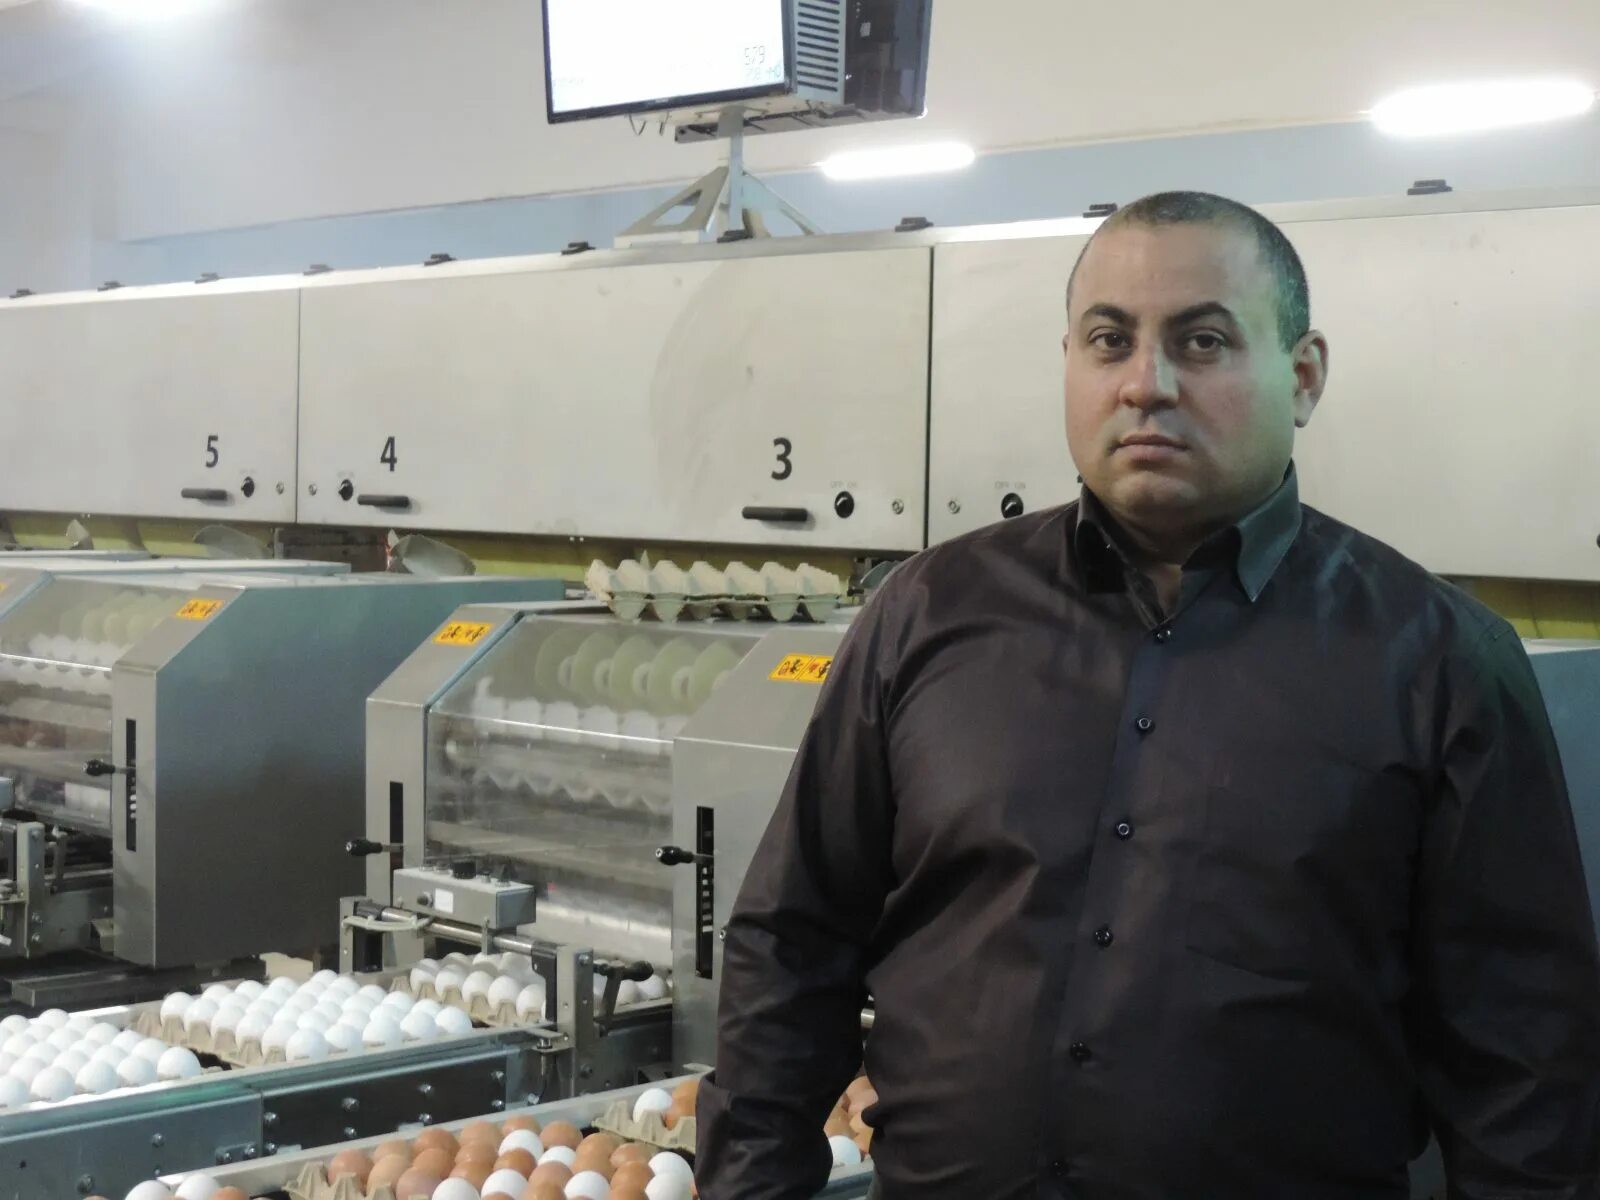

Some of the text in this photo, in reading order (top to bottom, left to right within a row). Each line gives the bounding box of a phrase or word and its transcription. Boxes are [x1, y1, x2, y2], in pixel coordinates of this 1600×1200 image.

[205, 435, 219, 468] 5
[380, 436, 398, 472] 4
[771, 437, 792, 481] 3
